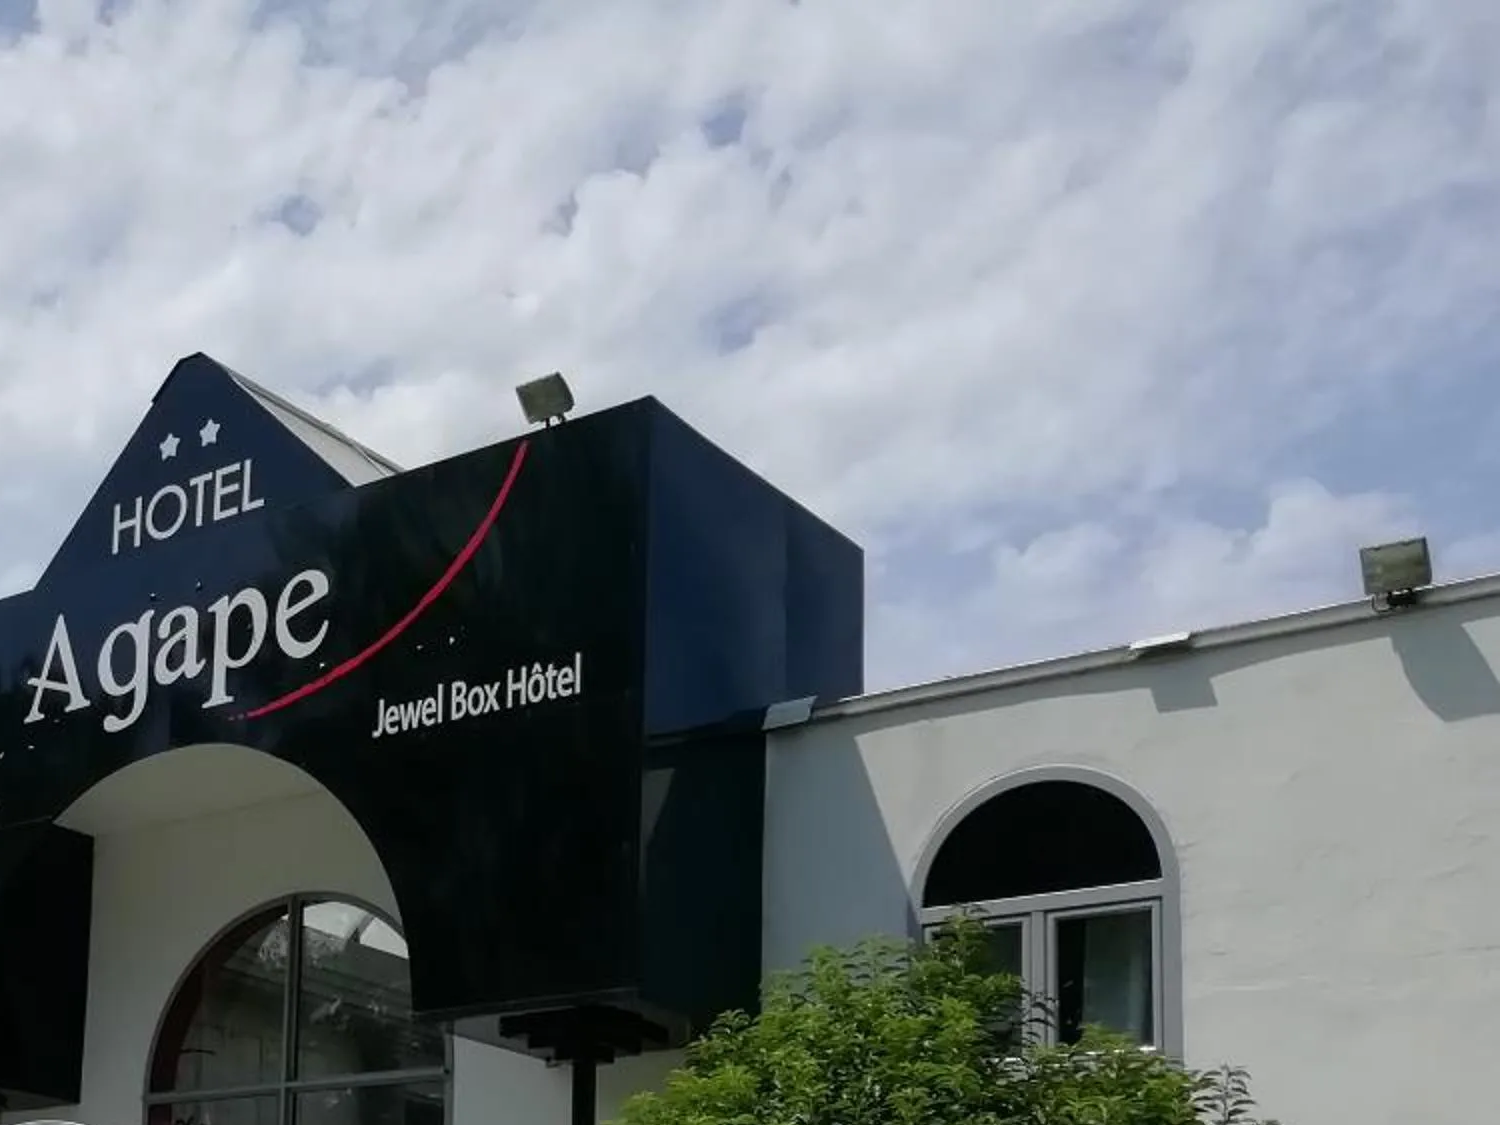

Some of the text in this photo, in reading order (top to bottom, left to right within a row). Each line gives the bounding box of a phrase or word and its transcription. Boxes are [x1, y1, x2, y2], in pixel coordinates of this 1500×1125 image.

[111, 459, 265, 556] HOTEL
[23, 568, 330, 733] Agape
[371, 651, 583, 739] Jewel Box Hôtel
